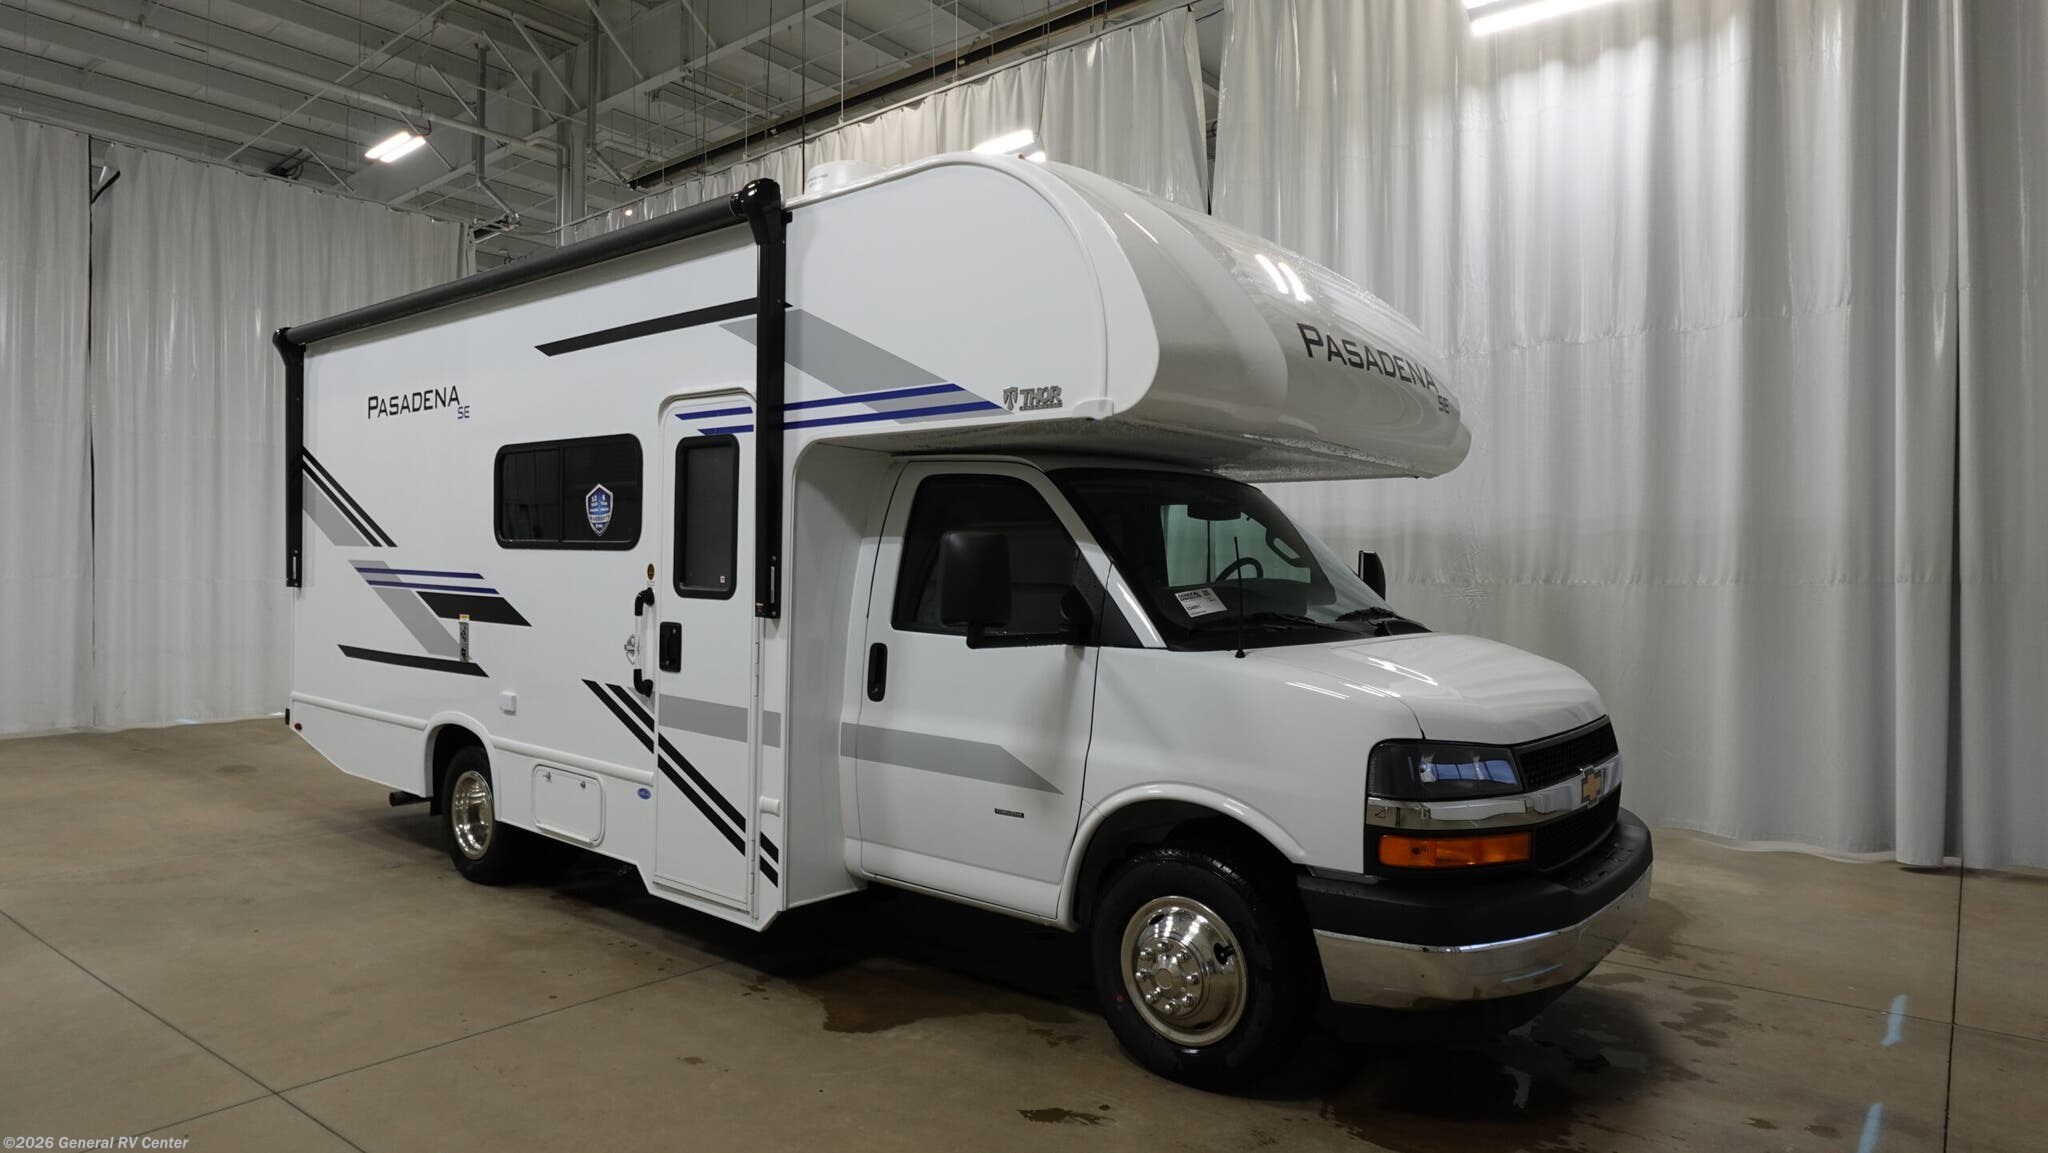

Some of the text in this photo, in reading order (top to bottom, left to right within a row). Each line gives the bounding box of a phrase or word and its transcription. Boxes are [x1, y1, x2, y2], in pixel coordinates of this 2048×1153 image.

[1297, 322, 1450, 414] PASADENA SE
[368, 385, 471, 420] PASADENA SE
[1019, 386, 1063, 406] THOR
